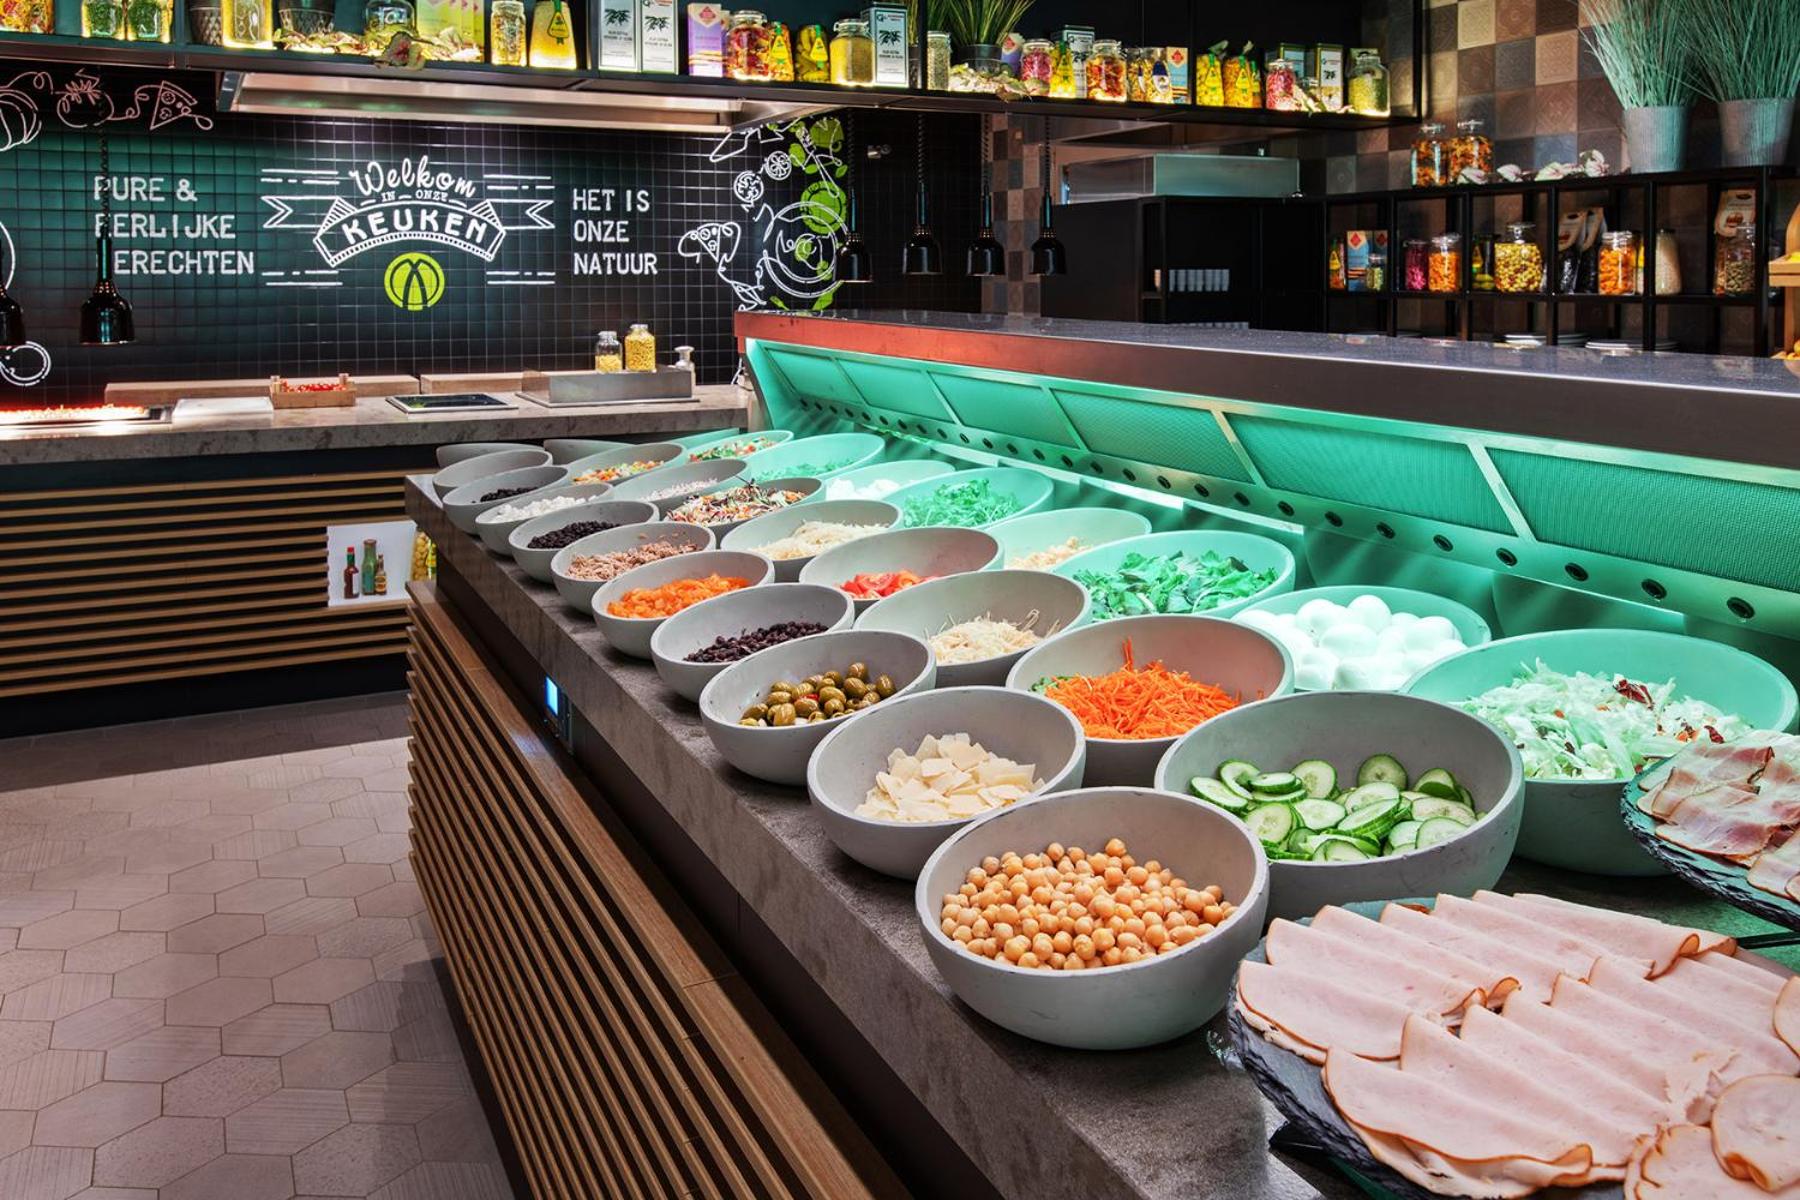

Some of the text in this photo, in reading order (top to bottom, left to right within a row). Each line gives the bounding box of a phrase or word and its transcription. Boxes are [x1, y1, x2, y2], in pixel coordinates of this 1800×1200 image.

[349, 155, 476, 198] Welkom
[93, 176, 198, 202] PURE &
[381, 189, 448, 202] IN ONZE
[573, 188, 650, 212] HET IS
[341, 208, 487, 245] KEUKEN
[574, 219, 630, 242] ONZE
[96, 250, 254, 275] ERECHTEN
[574, 252, 658, 275] NATUUR
